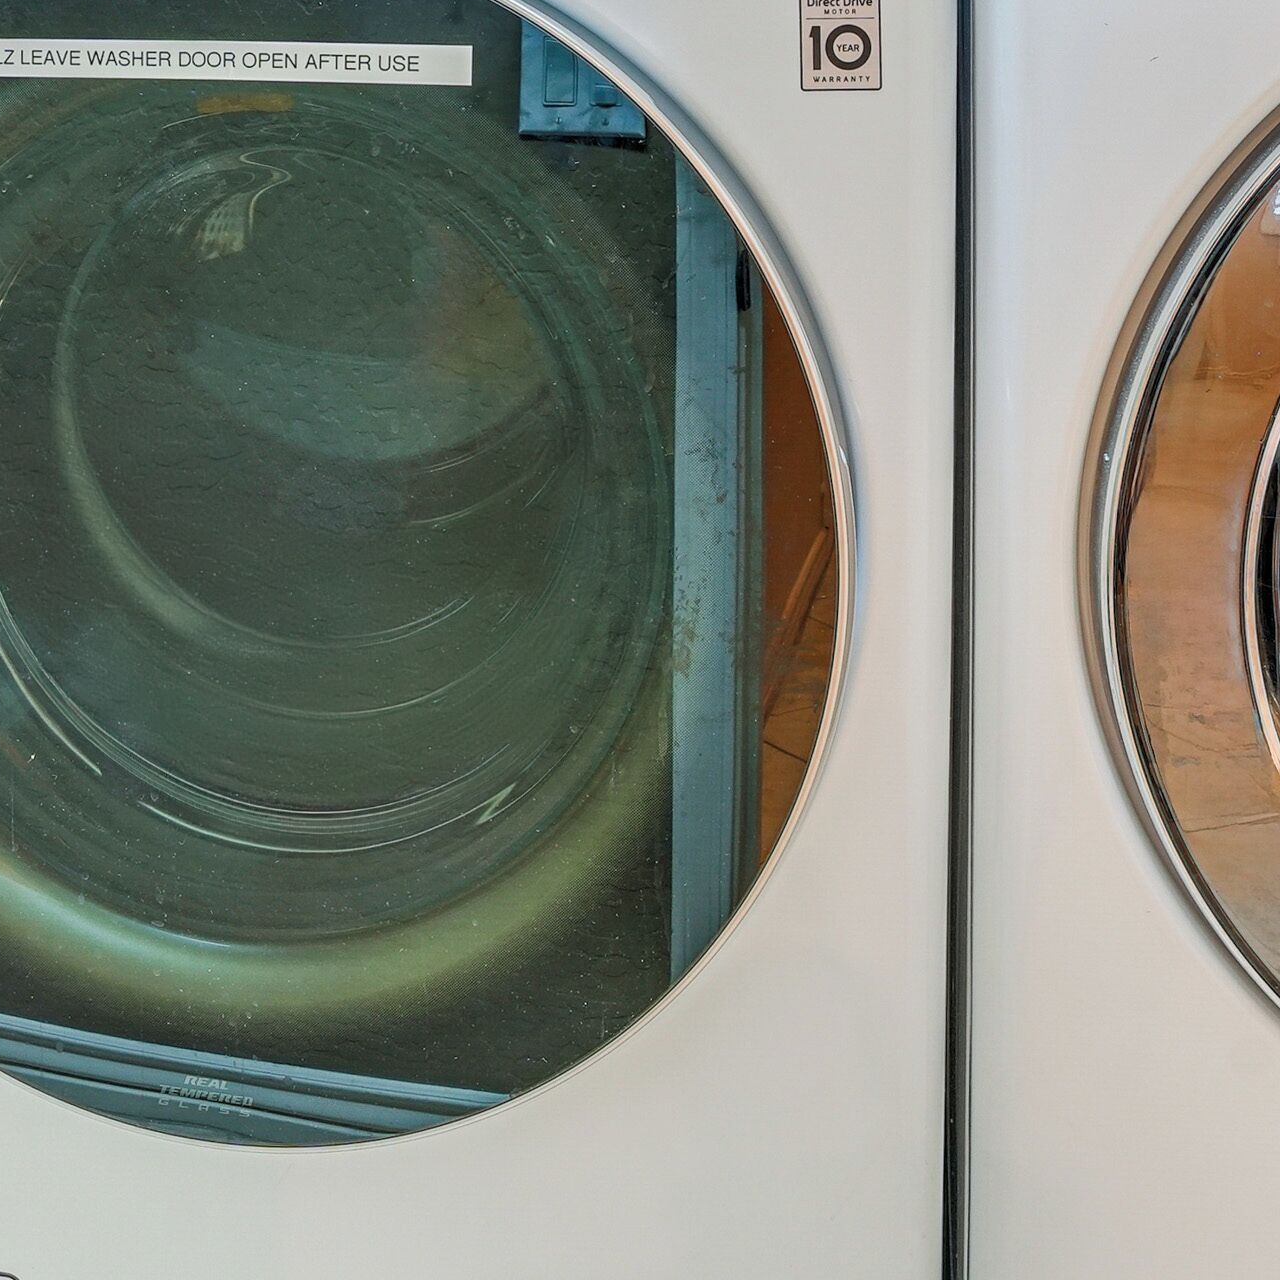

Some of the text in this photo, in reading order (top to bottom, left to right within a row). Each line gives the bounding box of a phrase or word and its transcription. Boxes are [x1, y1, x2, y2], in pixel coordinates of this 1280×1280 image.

[808, 24, 872, 71] 10
[836, 44, 860, 52] YEAR
[21, 49, 81, 67] LEAVE
[86, 50, 171, 68] WASHER
[178, 51, 236, 69] DOOR
[242, 52, 298, 70] OPEN
[304, 53, 372, 71] AFTER
[378, 54, 420, 72] USE
[184, 1075, 229, 1091] REAL
[158, 1084, 254, 1107] TEMPERED
[158, 1098, 252, 1118] GLASS
